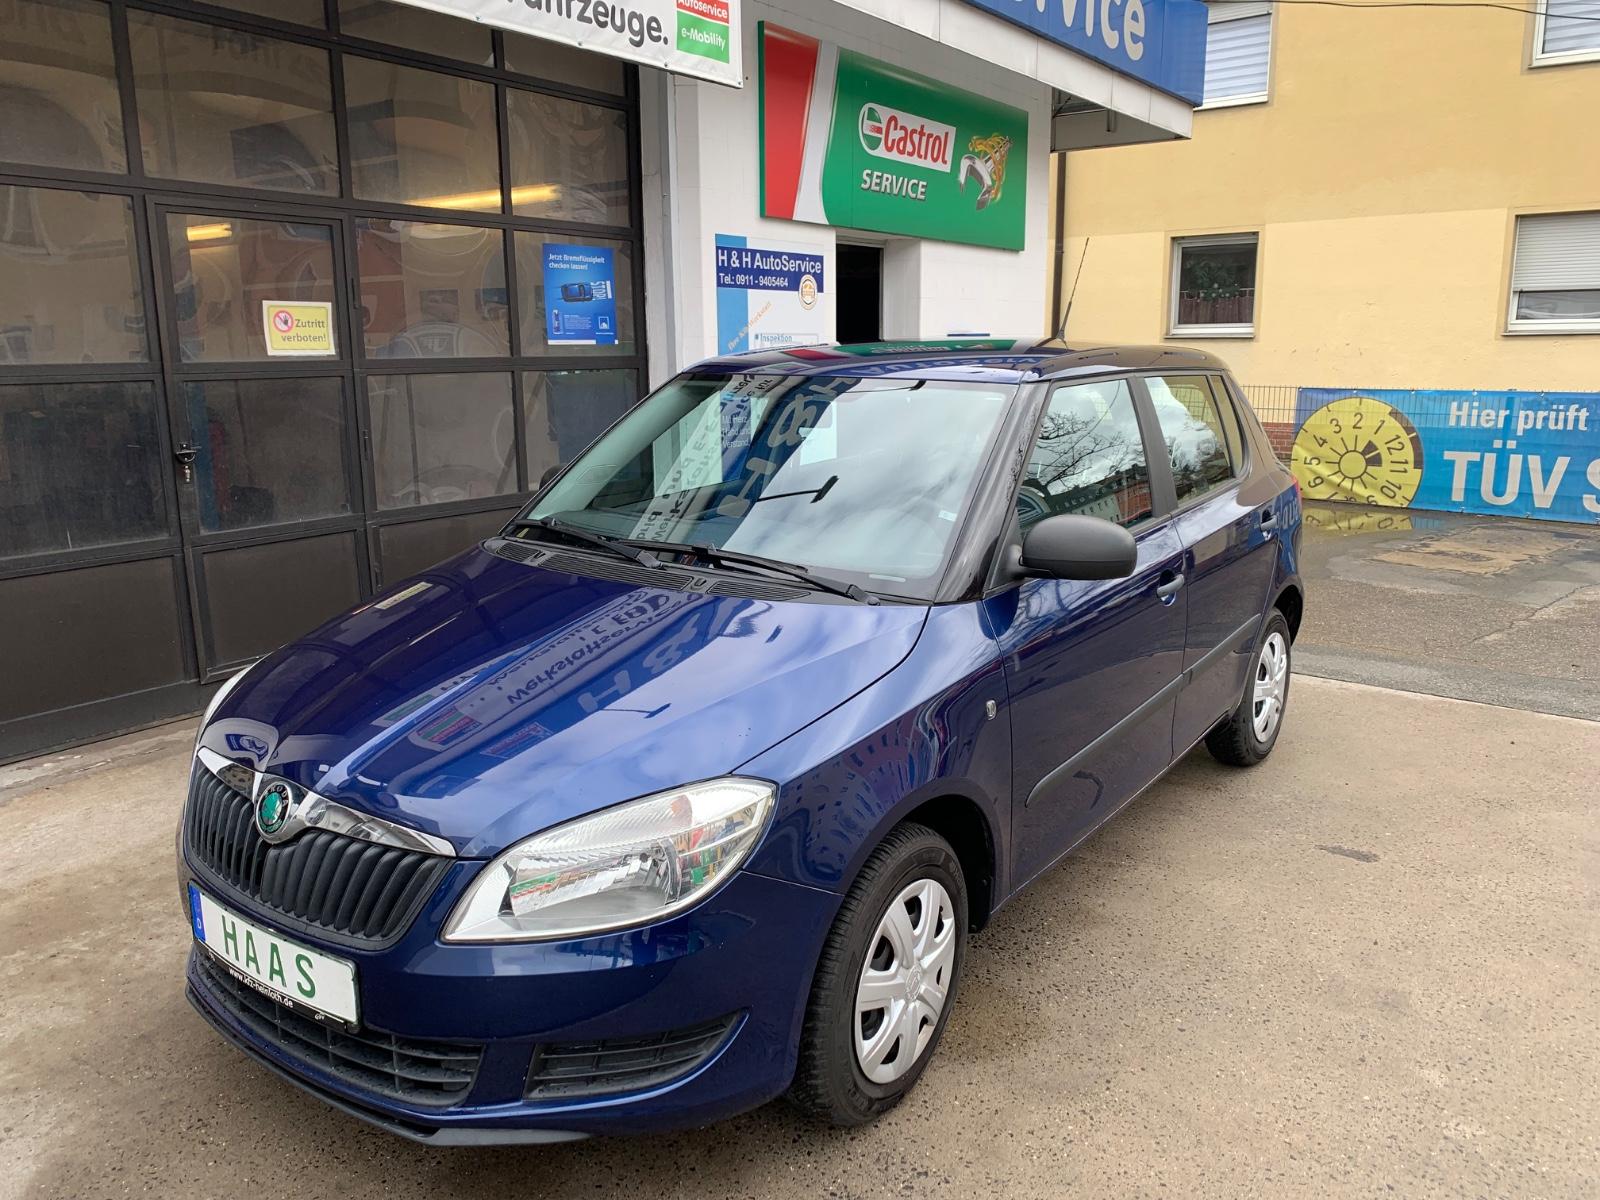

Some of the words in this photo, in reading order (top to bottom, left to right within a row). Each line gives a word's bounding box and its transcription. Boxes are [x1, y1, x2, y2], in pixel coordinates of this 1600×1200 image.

[507, 0, 669, 48] rzeuge.
[681, 27, 726, 52] e-Mobility
[884, 115, 949, 165] Castrol
[861, 169, 928, 201] SERVICE
[718, 249, 728, 267] H
[730, 250, 740, 268] &
[742, 251, 752, 268] H
[754, 252, 822, 274] AutoService
[736, 274, 754, 286] 0911
[758, 275, 789, 288] 9405464
[295, 318, 325, 328] Zutritt
[280, 332, 326, 342] verboten!
[760, 333, 793, 344] Inspektion
[1329, 418, 1342, 434] 3
[1352, 412, 1364, 430] 2
[1374, 419, 1386, 435] 1
[1449, 401, 1510, 429] Hier
[1516, 404, 1590, 436] prüft
[1313, 434, 1329, 448] 4
[1384, 434, 1406, 456] 12
[1304, 456, 1321, 466] 5
[1390, 458, 1409, 474] 11
[1443, 439, 1571, 509] TÜV
[1380, 480, 1402, 500] 10
[221, 914, 316, 999] HAAS
